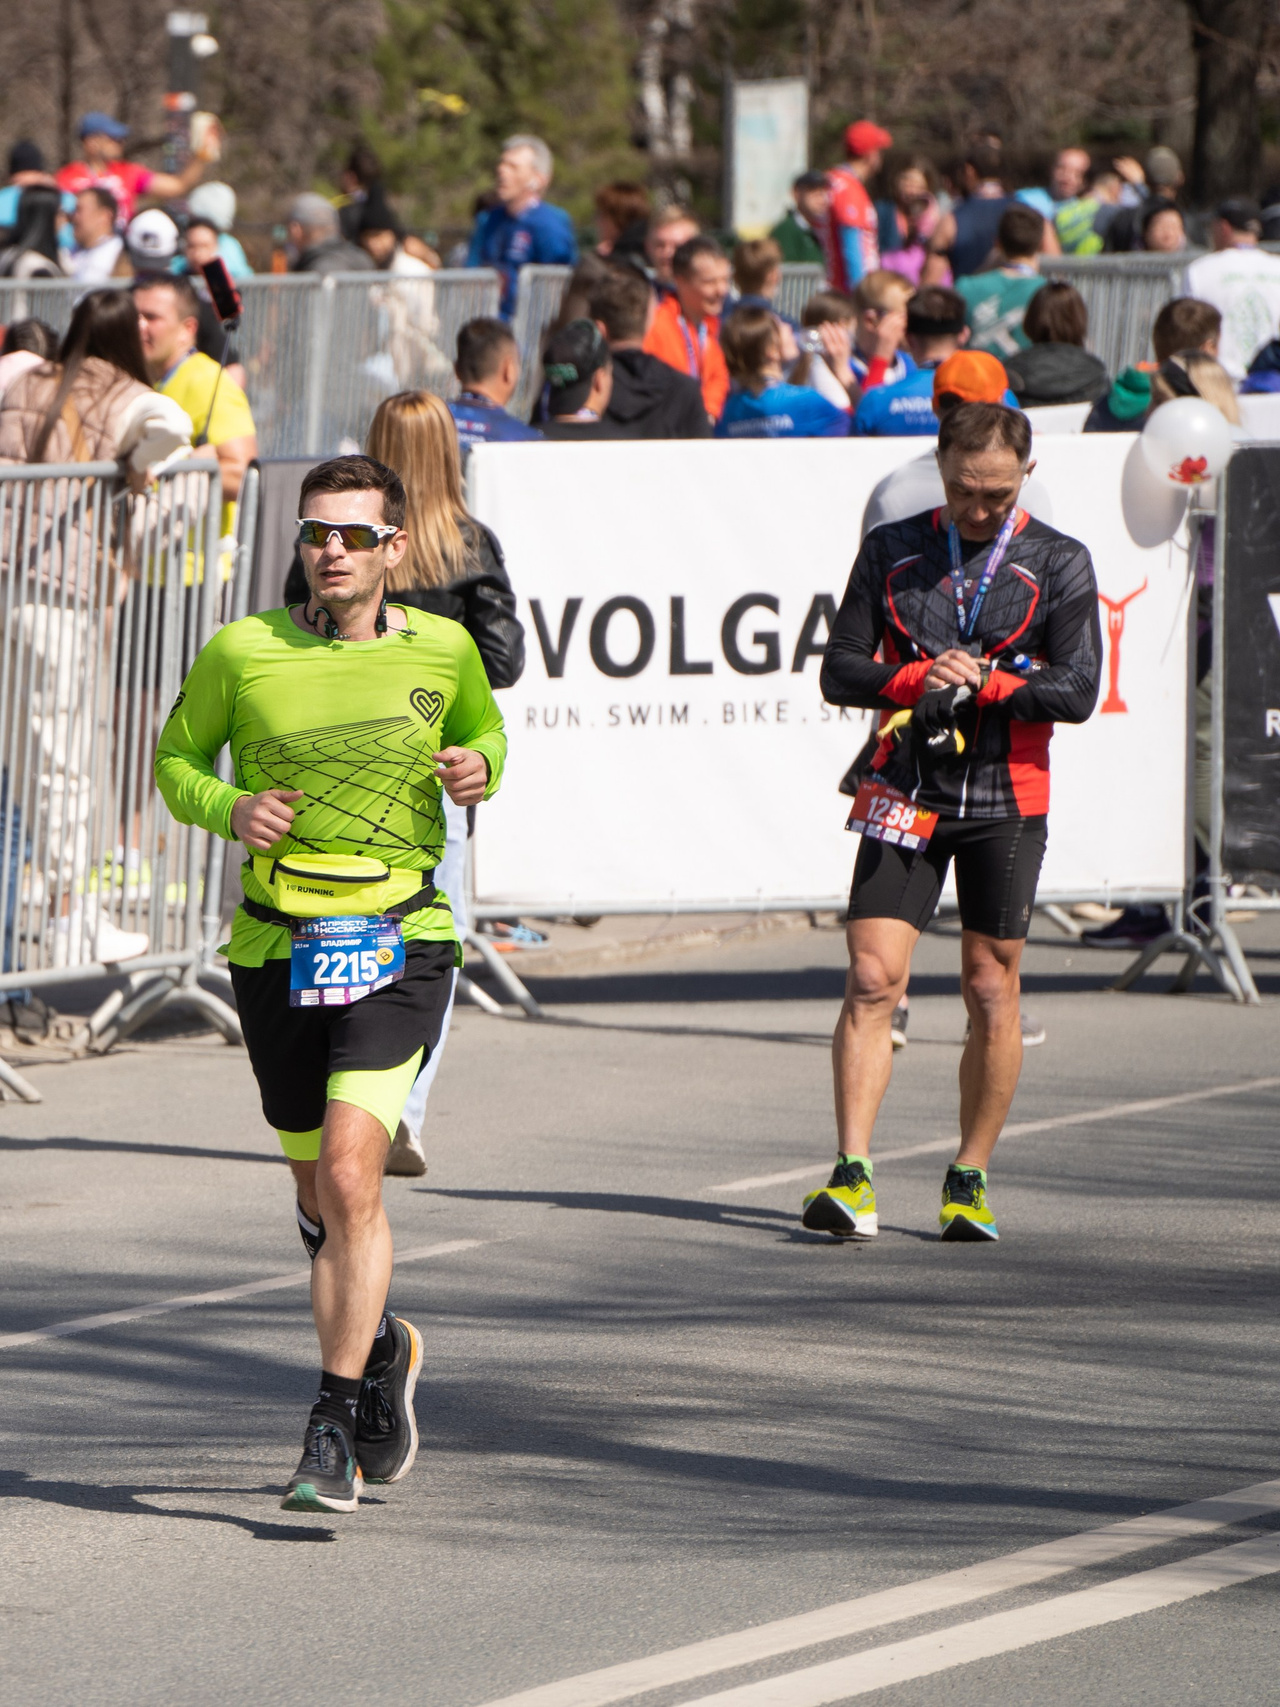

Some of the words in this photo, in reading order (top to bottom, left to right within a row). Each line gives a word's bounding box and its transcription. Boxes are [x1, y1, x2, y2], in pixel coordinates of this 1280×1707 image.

[866, 795, 918, 831] 1258
[297, 885, 335, 897] RUNNING
[321, 939, 362, 947] ВЛАДИМИР
[313, 950, 380, 985] 2215
